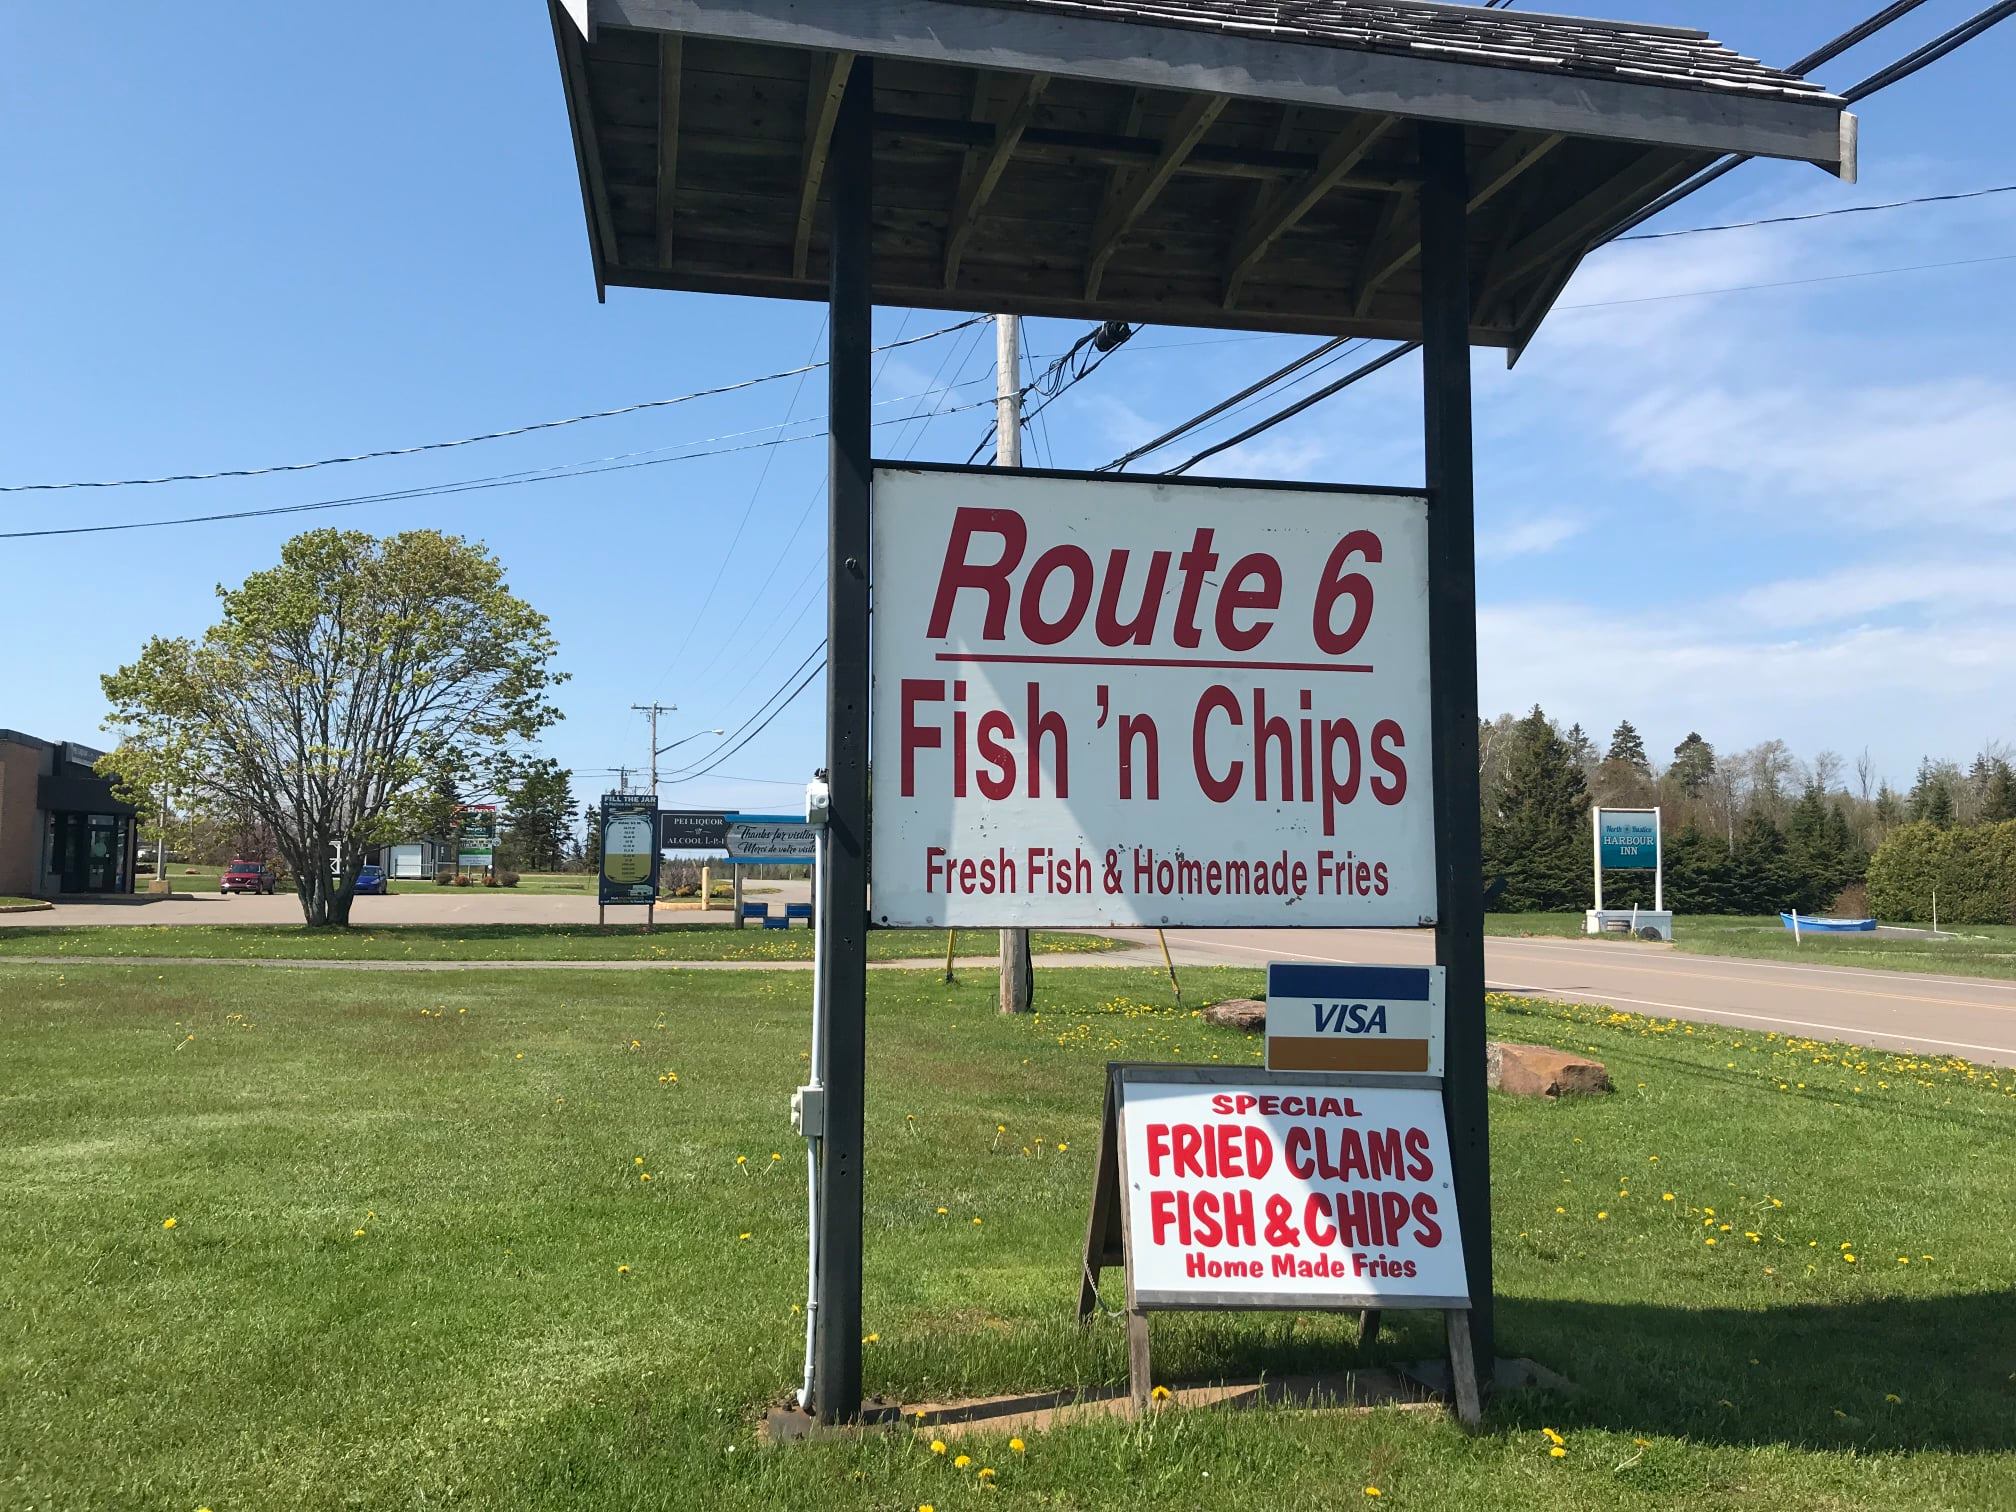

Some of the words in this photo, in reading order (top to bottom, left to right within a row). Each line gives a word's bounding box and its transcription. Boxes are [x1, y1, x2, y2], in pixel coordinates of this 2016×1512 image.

[926, 506, 1283, 652] Route
[1312, 529, 1383, 655] 6
[900, 679, 1069, 801] Fish
[1192, 684, 1408, 837] Chips
[690, 818, 723, 826] LIQUOR
[1606, 825, 1623, 833] North
[737, 825, 771, 840] Thanks
[771, 828, 786, 843] for
[788, 829, 816, 844] visiting
[1603, 836, 1654, 845] HARBOUR
[737, 841, 768, 854] Merci
[768, 844, 777, 853] de
[779, 844, 797, 854] votre
[1620, 846, 1638, 855] INN
[926, 846, 1016, 895] Fresh
[1027, 847, 1092, 895] Fish
[1103, 849, 1123, 896] &
[1133, 849, 1308, 896] Homemade
[1317, 850, 1389, 897] Fries
[1312, 1003, 1388, 1034] VISA
[1211, 1094, 1363, 1117] SPECIAL
[1146, 1123, 1274, 1180] FRIED
[1284, 1126, 1434, 1183] CLAMS
[1186, 1252, 1264, 1278] Home
[1271, 1252, 1345, 1278] Made
[1352, 1253, 1417, 1278] Fries
